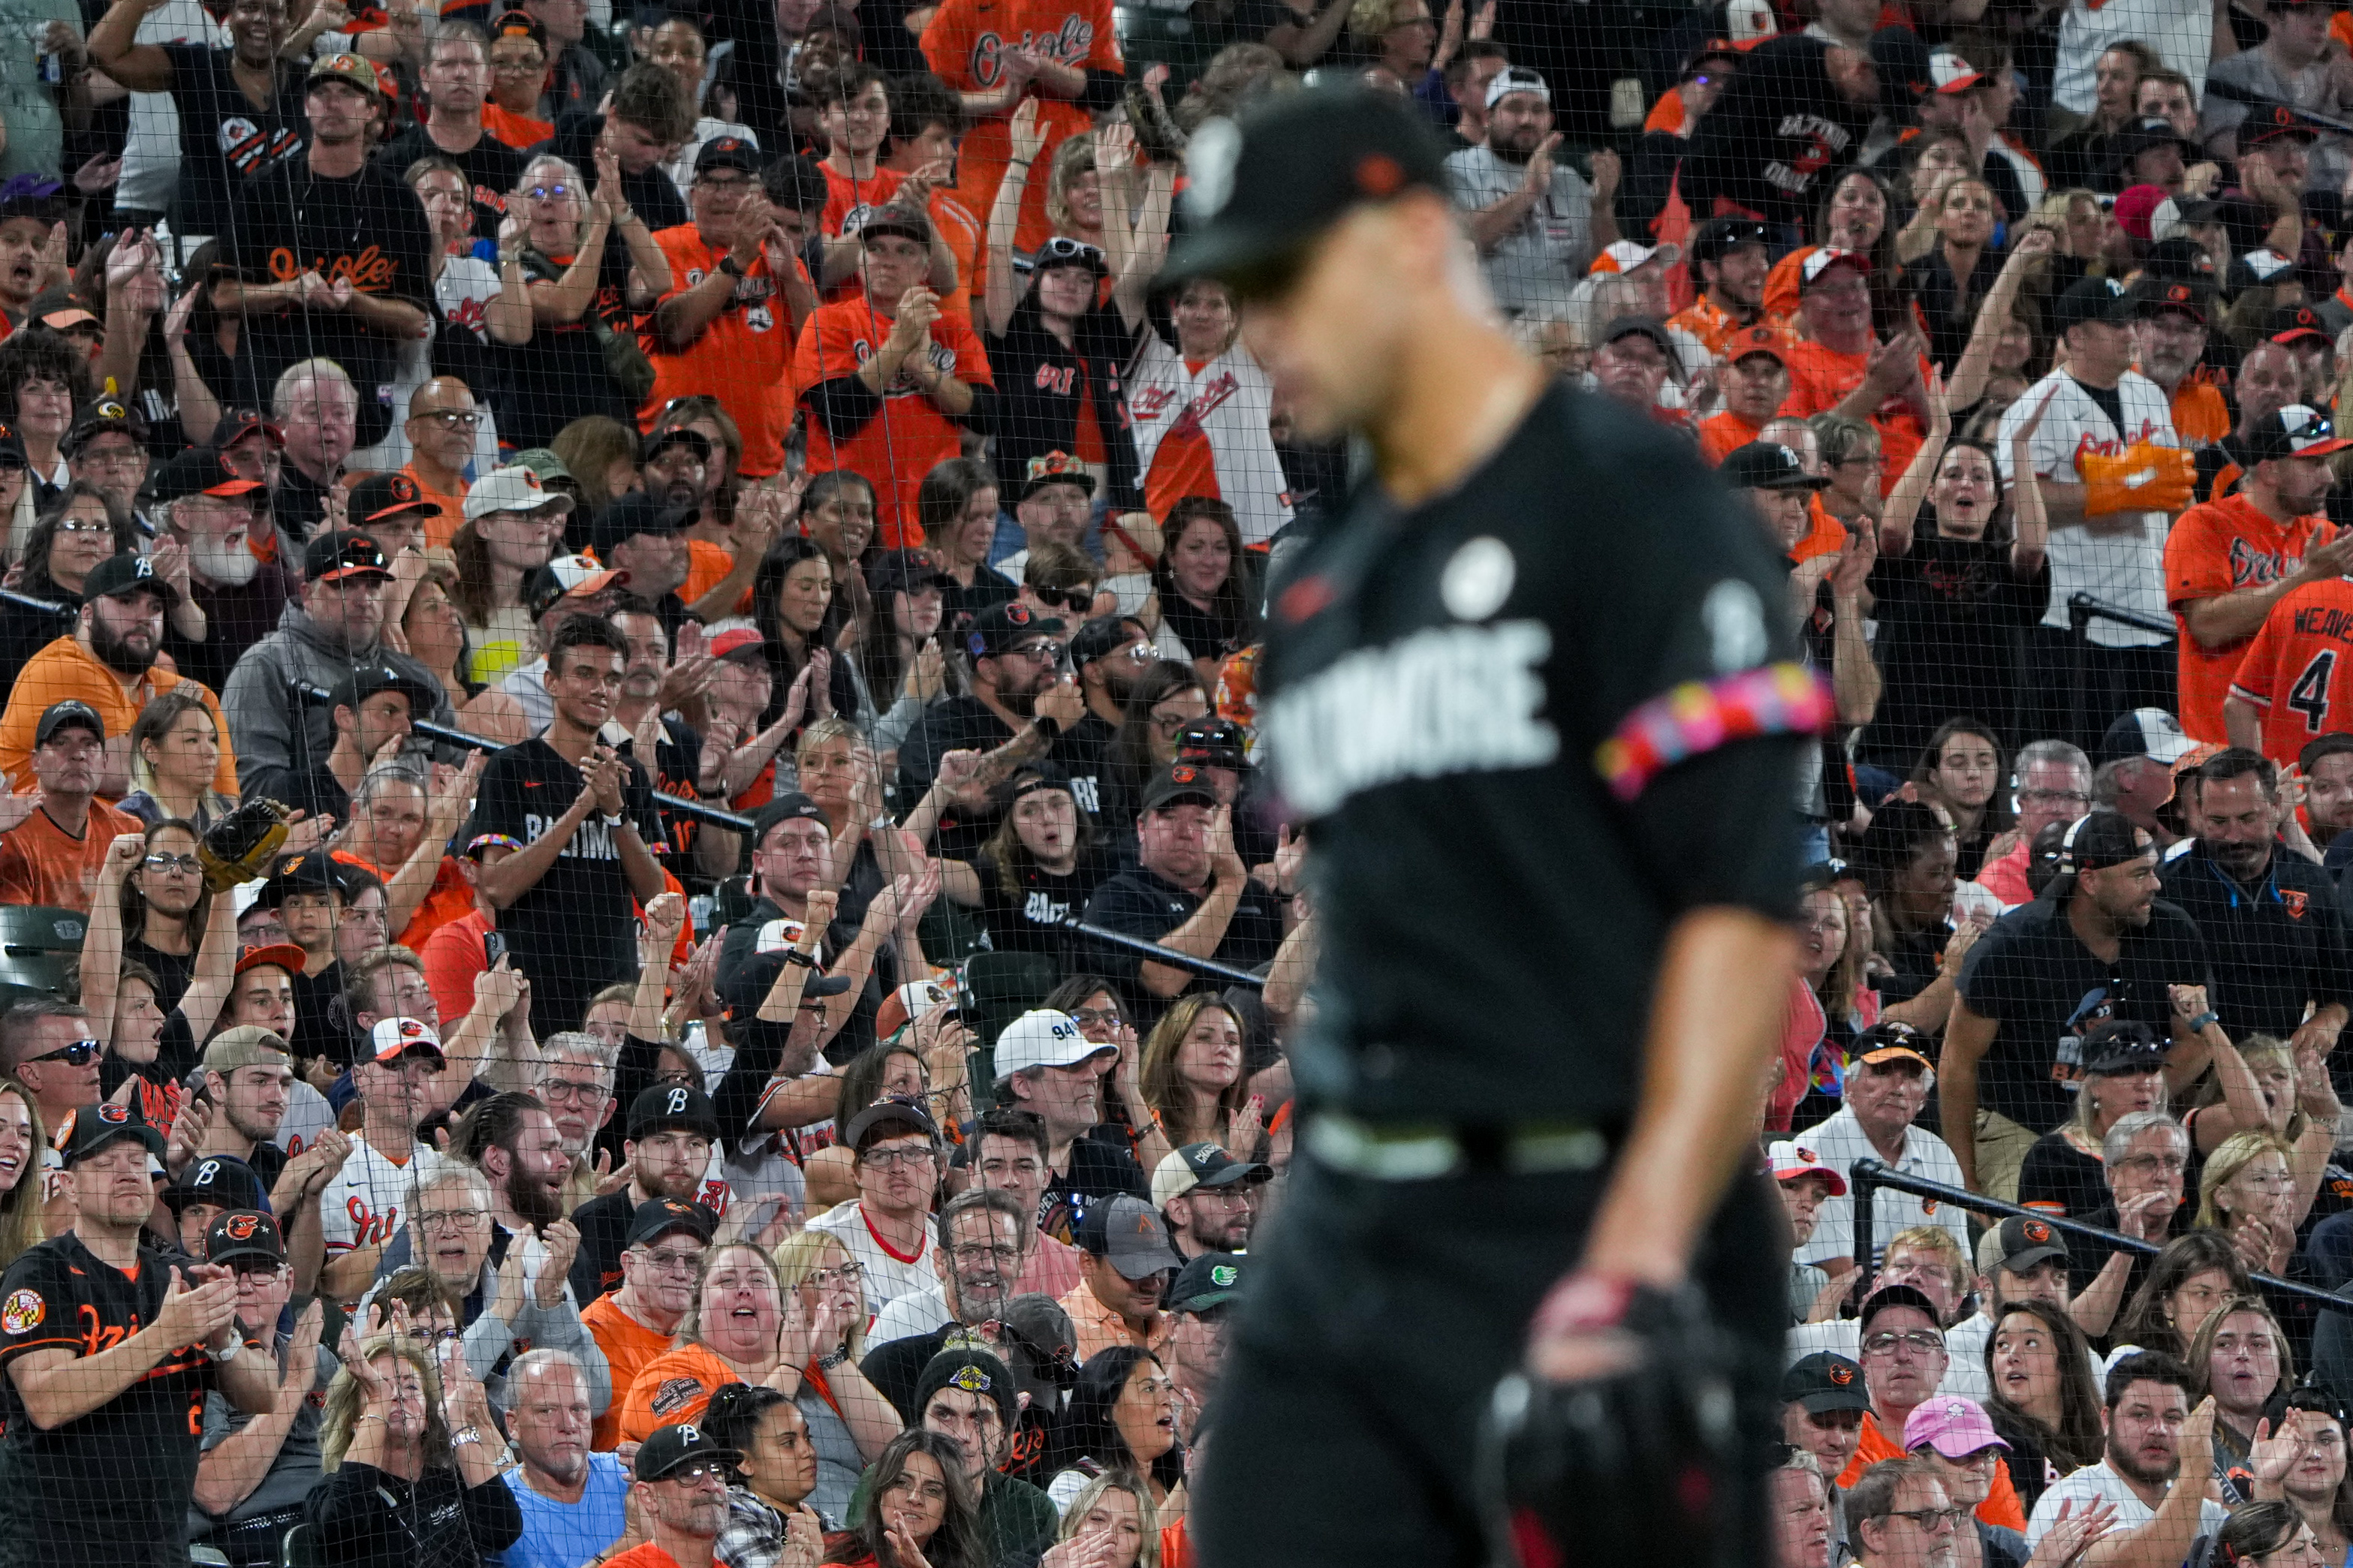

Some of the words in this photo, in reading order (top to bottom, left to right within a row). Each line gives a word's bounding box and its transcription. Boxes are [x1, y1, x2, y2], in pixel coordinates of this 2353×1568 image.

[134, 555, 153, 579] B
[2287, 649, 2337, 734] 4
[667, 1087, 688, 1115] B
[194, 1160, 221, 1187] B
[678, 1378, 697, 1391] PARK
[677, 1424, 700, 1447] B
